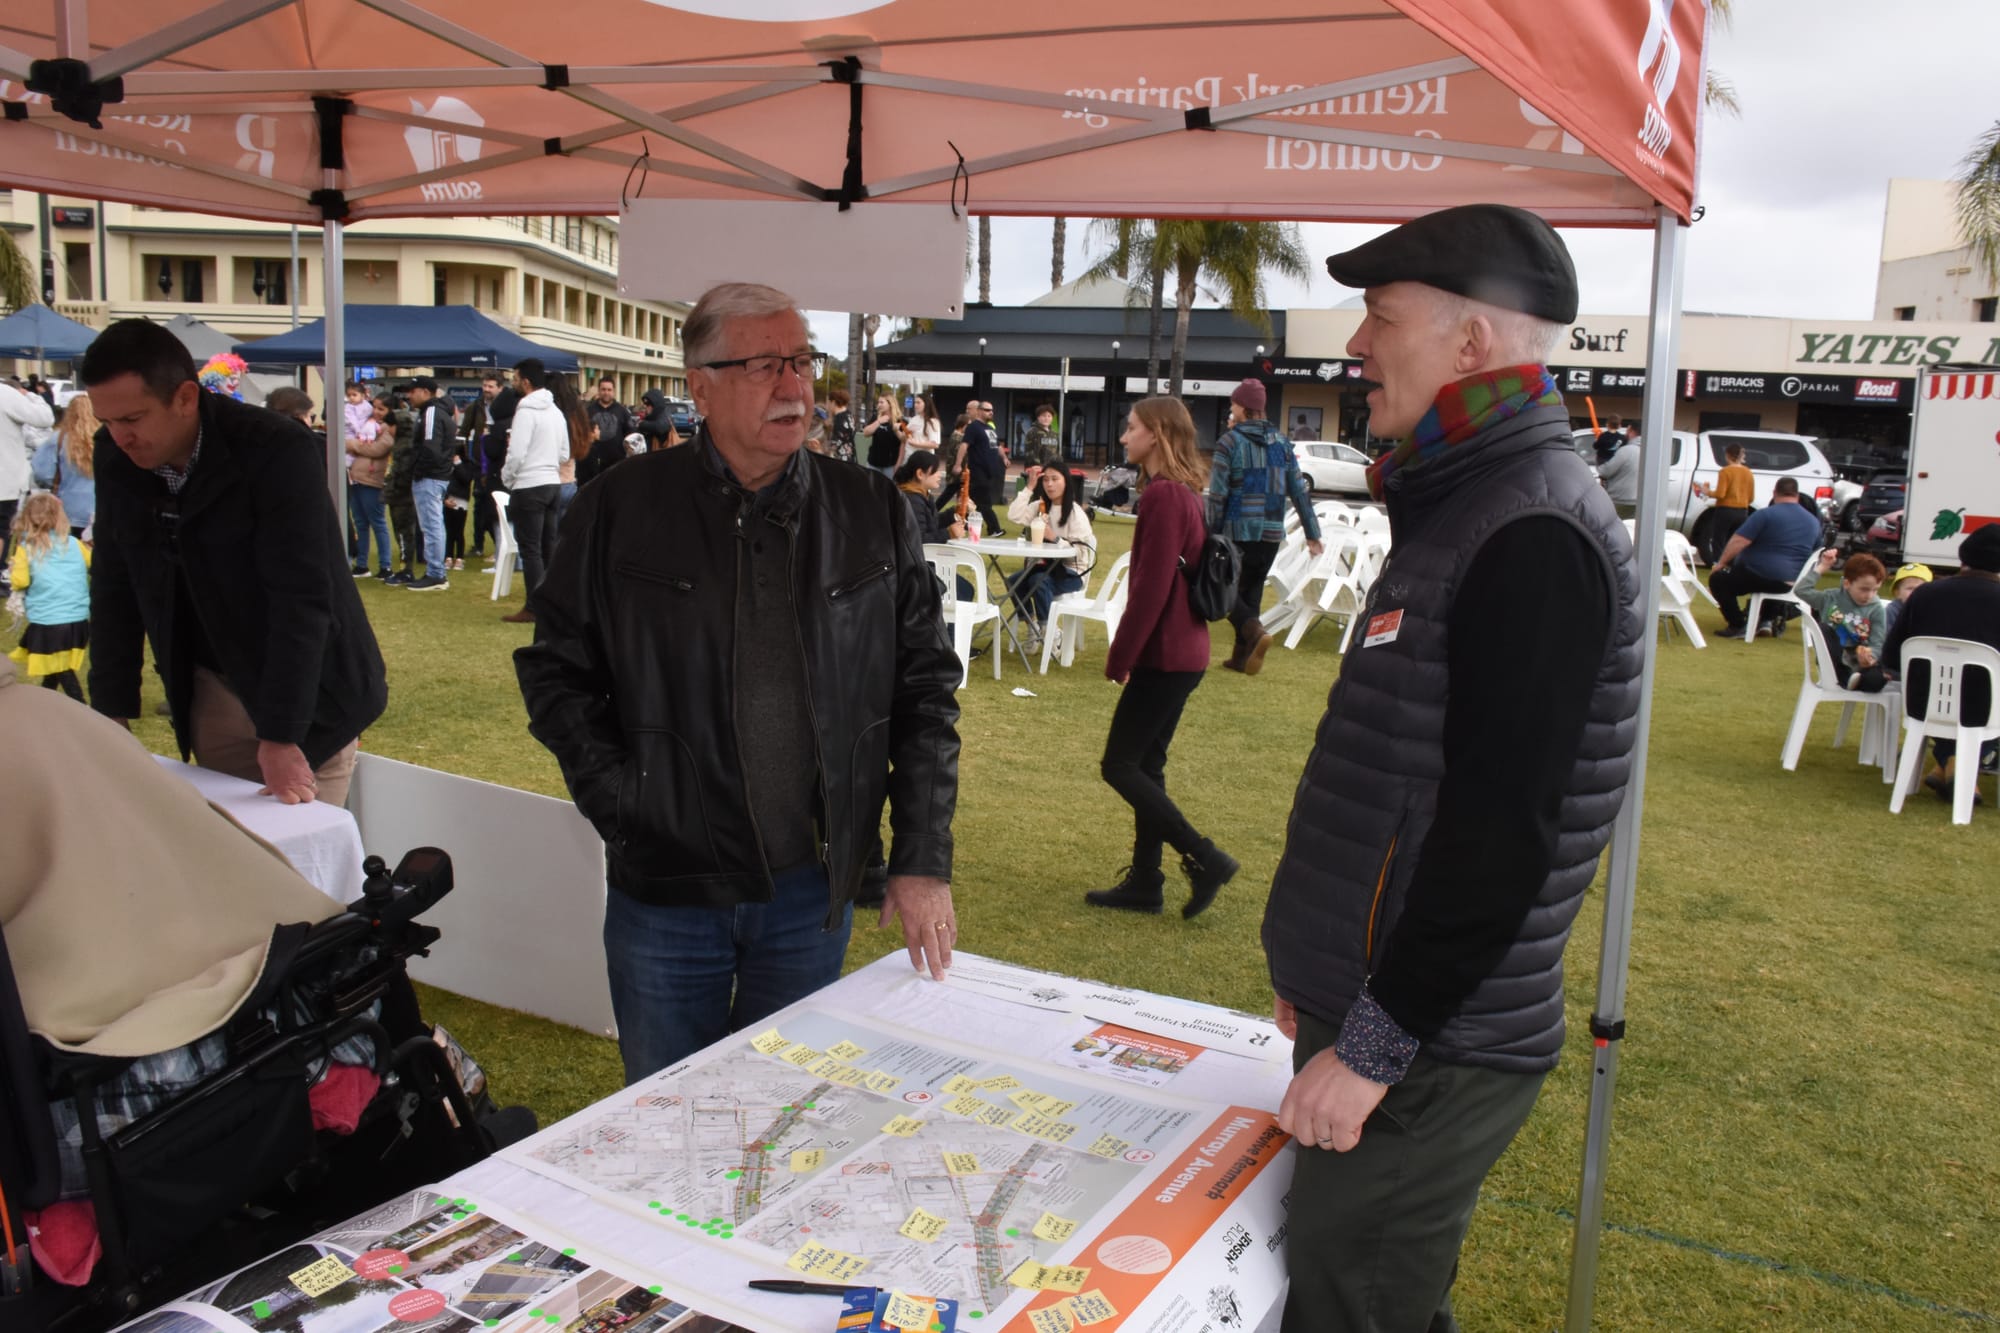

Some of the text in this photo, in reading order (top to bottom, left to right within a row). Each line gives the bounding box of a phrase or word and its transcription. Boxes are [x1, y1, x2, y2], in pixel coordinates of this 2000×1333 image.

[1570, 326, 1629, 352] Surf
[1796, 333, 1960, 365] YATES
[1721, 376, 1765, 388] BRACKS
[1802, 383, 1839, 392] FARAH
[1857, 379, 1896, 396] Rossi
[1134, 1009, 1234, 1039] Renmark Paringa
[1193, 1017, 1240, 1034] Council
[1154, 1116, 1256, 1204] Murray Avenue
[1204, 1124, 1285, 1201] Revive Renmark
[1222, 1222, 1245, 1246] PLUS
[1223, 1231, 1254, 1265] JENSEN
[1266, 1222, 1289, 1253] aringa
